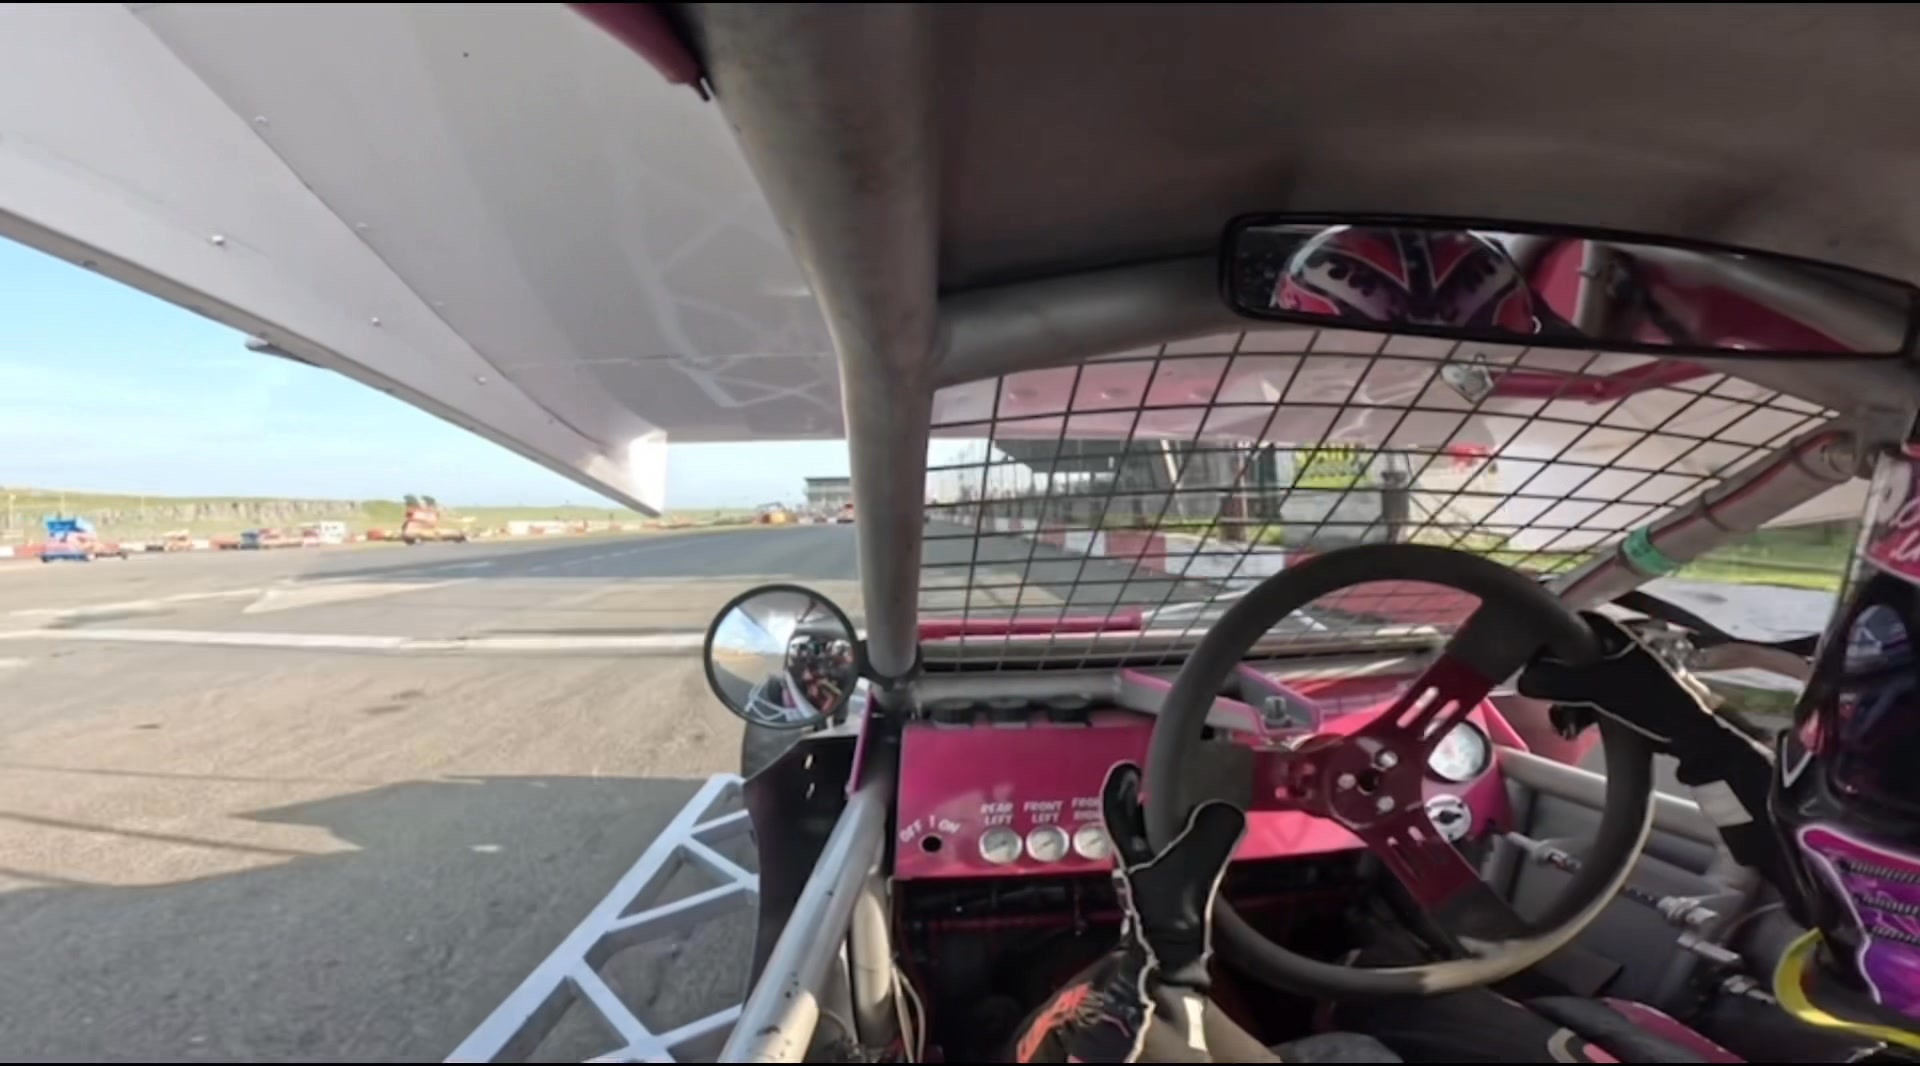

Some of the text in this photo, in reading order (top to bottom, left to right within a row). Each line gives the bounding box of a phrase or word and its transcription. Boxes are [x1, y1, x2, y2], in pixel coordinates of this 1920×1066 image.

[980, 802, 1014, 814] REAR
[1022, 800, 1064, 813] FRONT
[984, 814, 1013, 826] LEFT
[1030, 812, 1059, 824] LEFT
[899, 818, 961, 843] OFF ON
